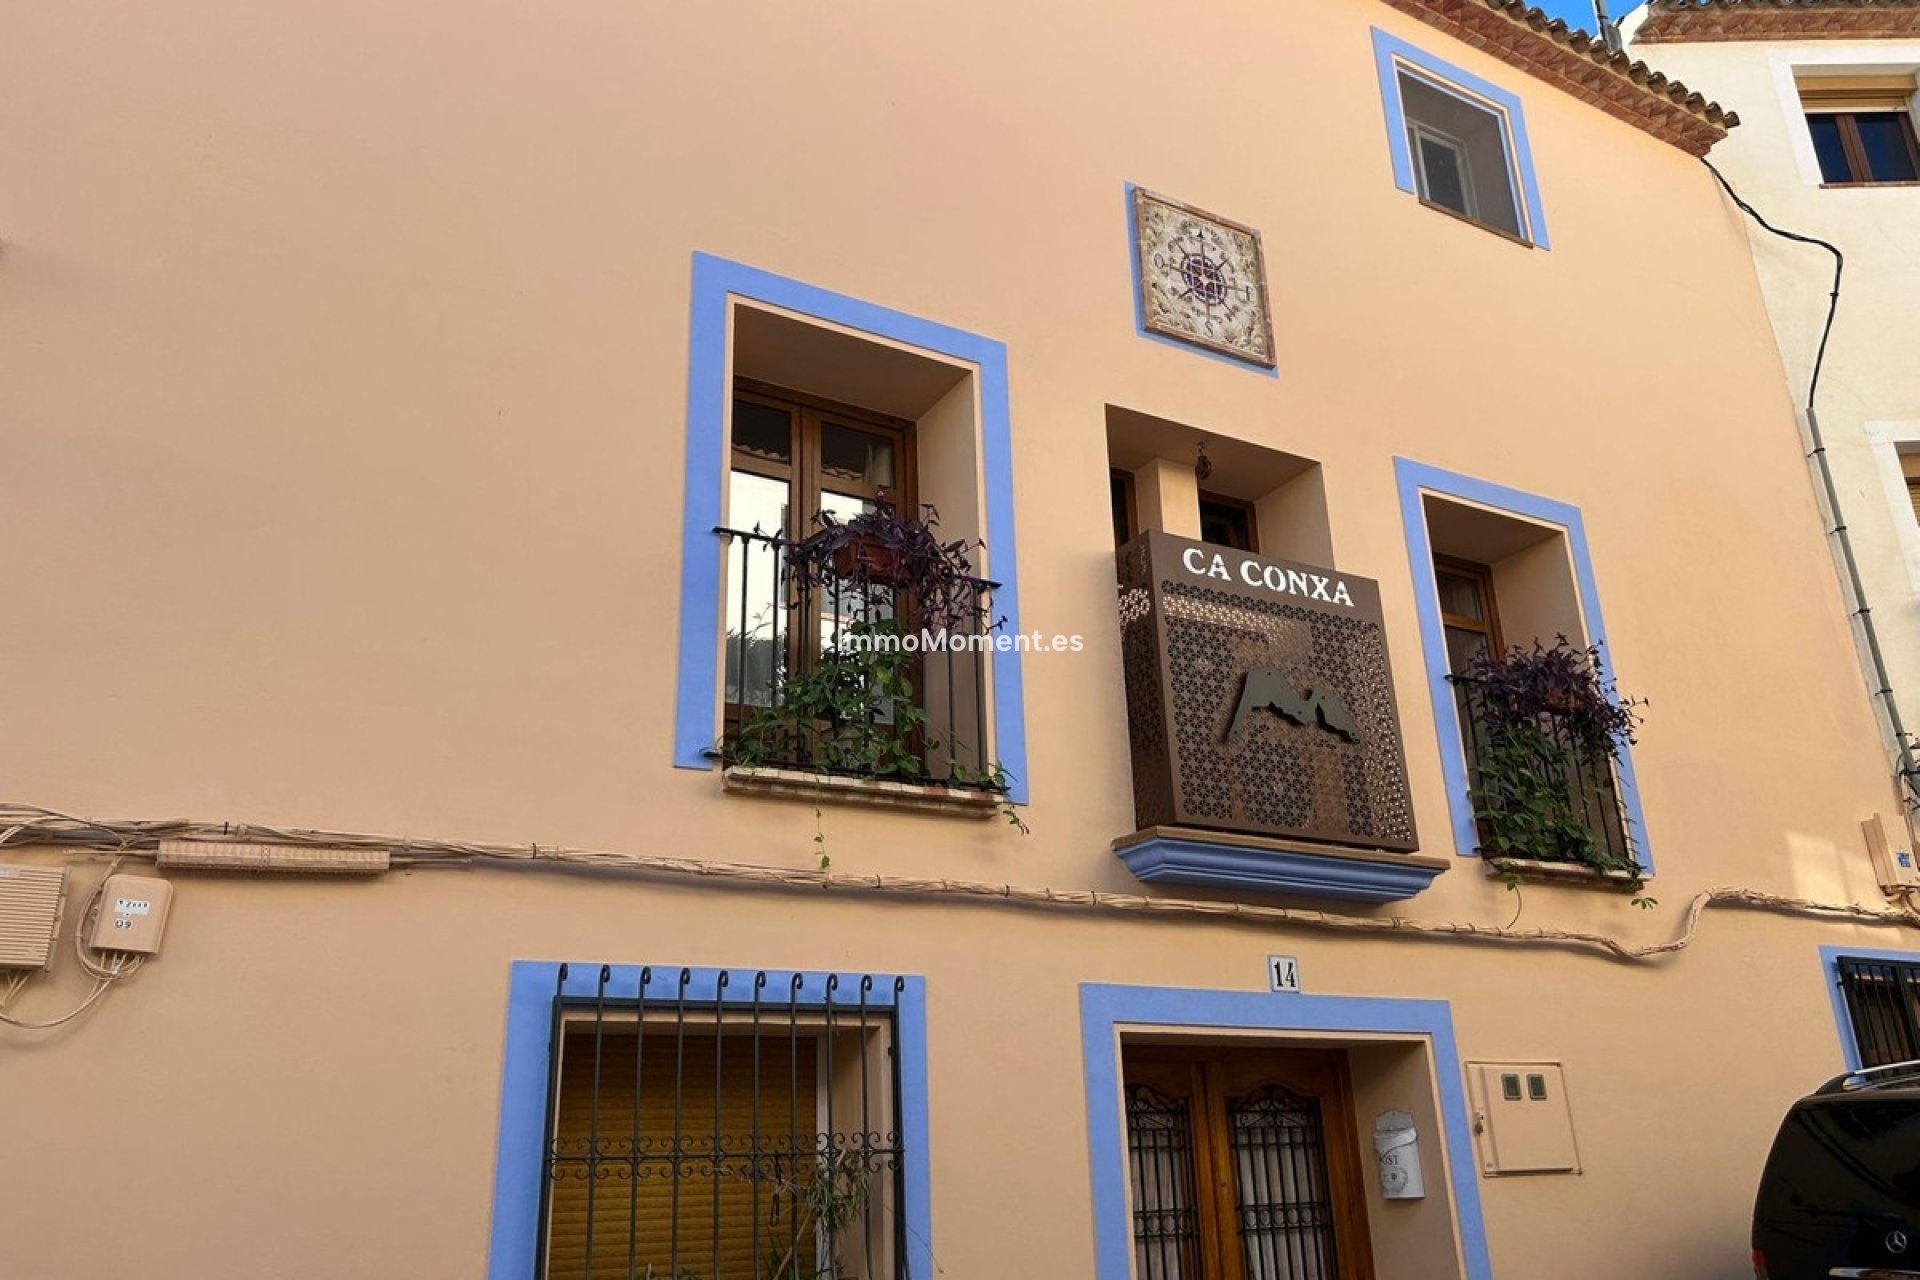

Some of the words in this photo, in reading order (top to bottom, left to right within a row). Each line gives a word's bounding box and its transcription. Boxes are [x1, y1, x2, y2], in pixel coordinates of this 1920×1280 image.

[1183, 548, 1231, 582] CA
[1241, 560, 1355, 607] CONXA
[1274, 961, 1296, 987] 14
